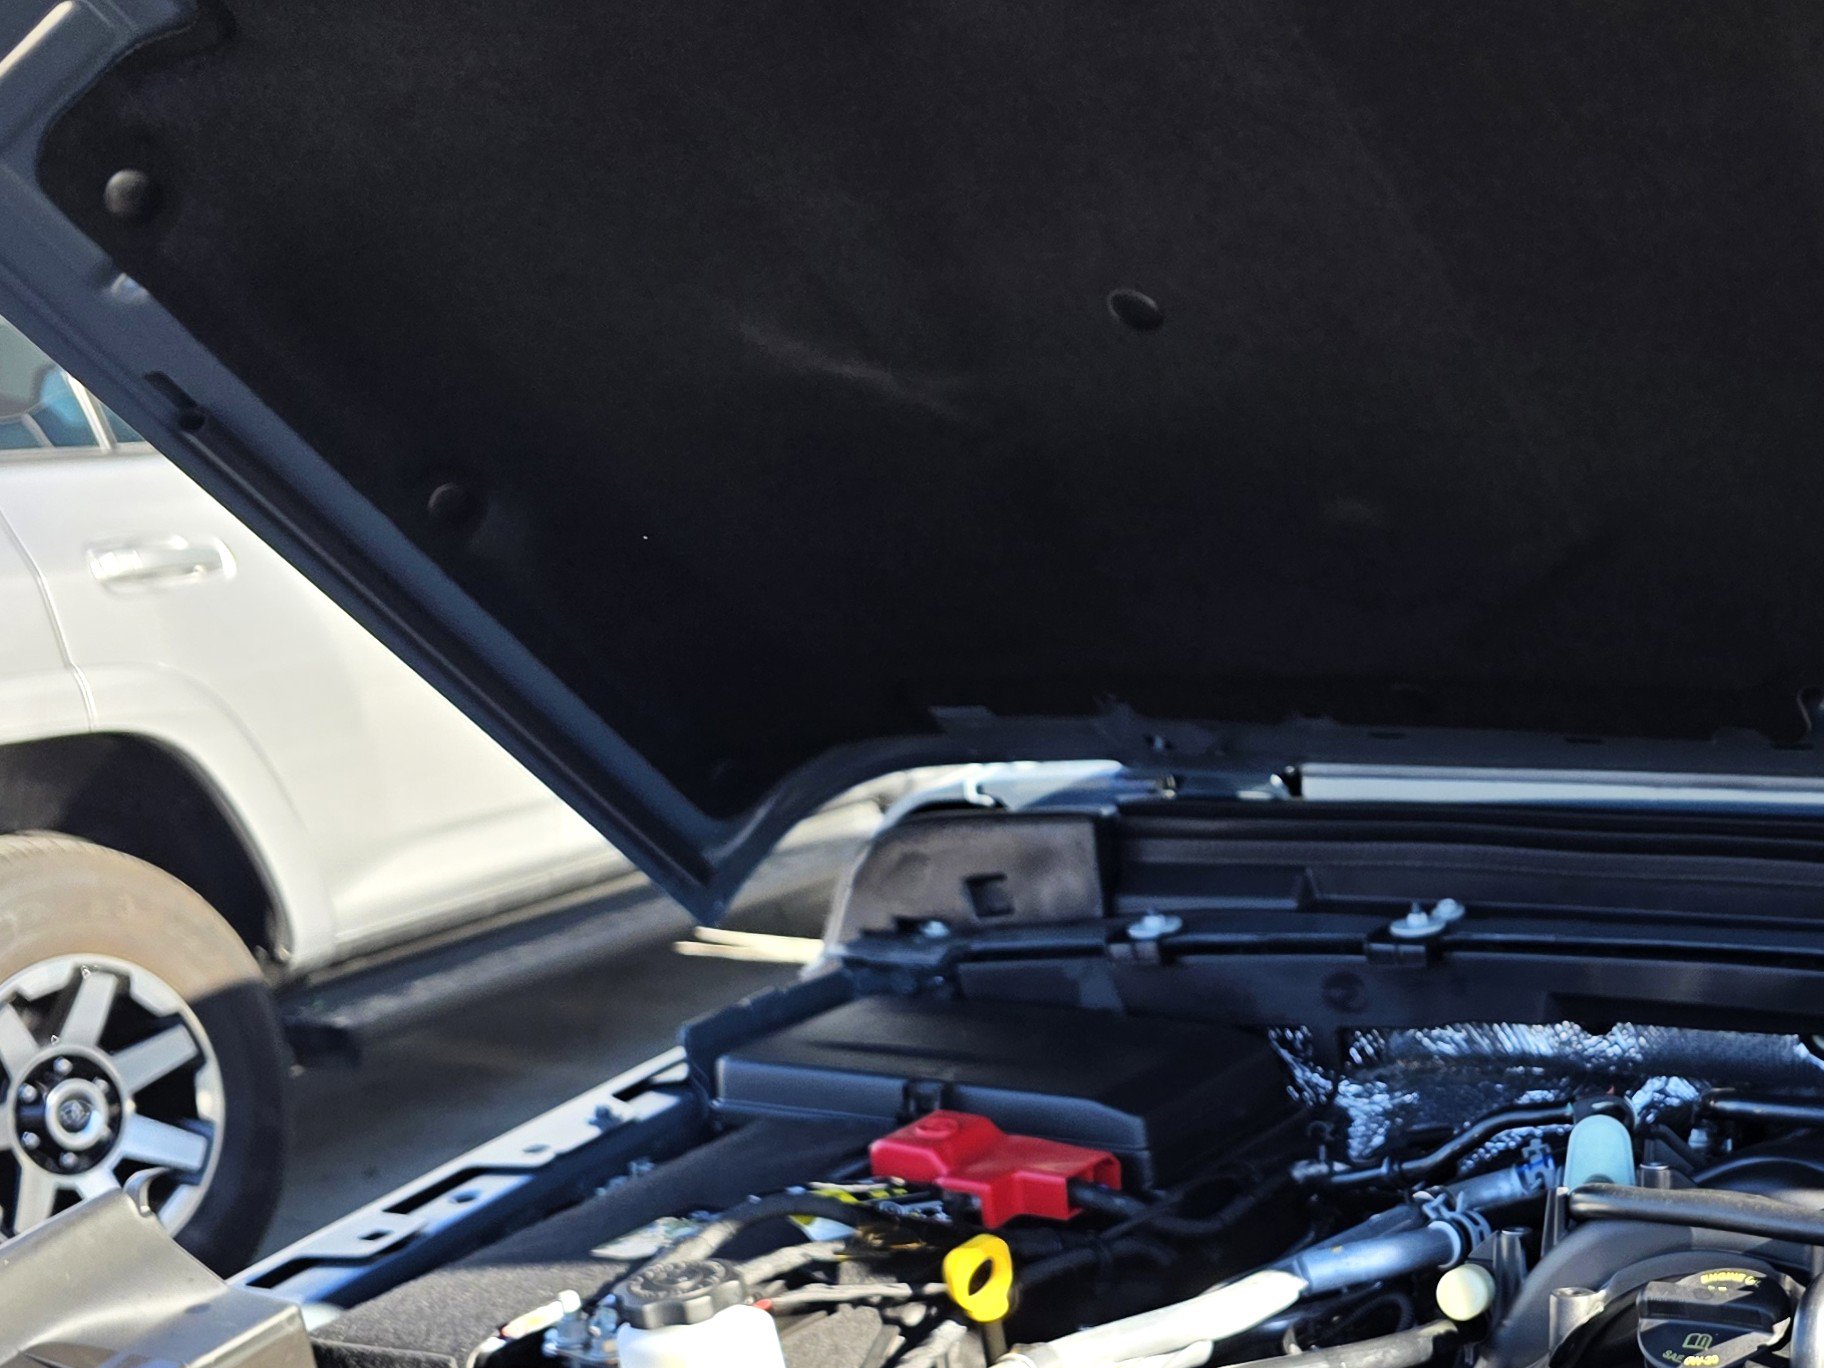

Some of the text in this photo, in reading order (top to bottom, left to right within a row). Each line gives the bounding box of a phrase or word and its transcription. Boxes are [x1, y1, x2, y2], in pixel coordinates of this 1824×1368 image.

[1700, 1271, 1747, 1284] ENGINE
[1662, 1349, 1720, 1367] SAE 0W-20
